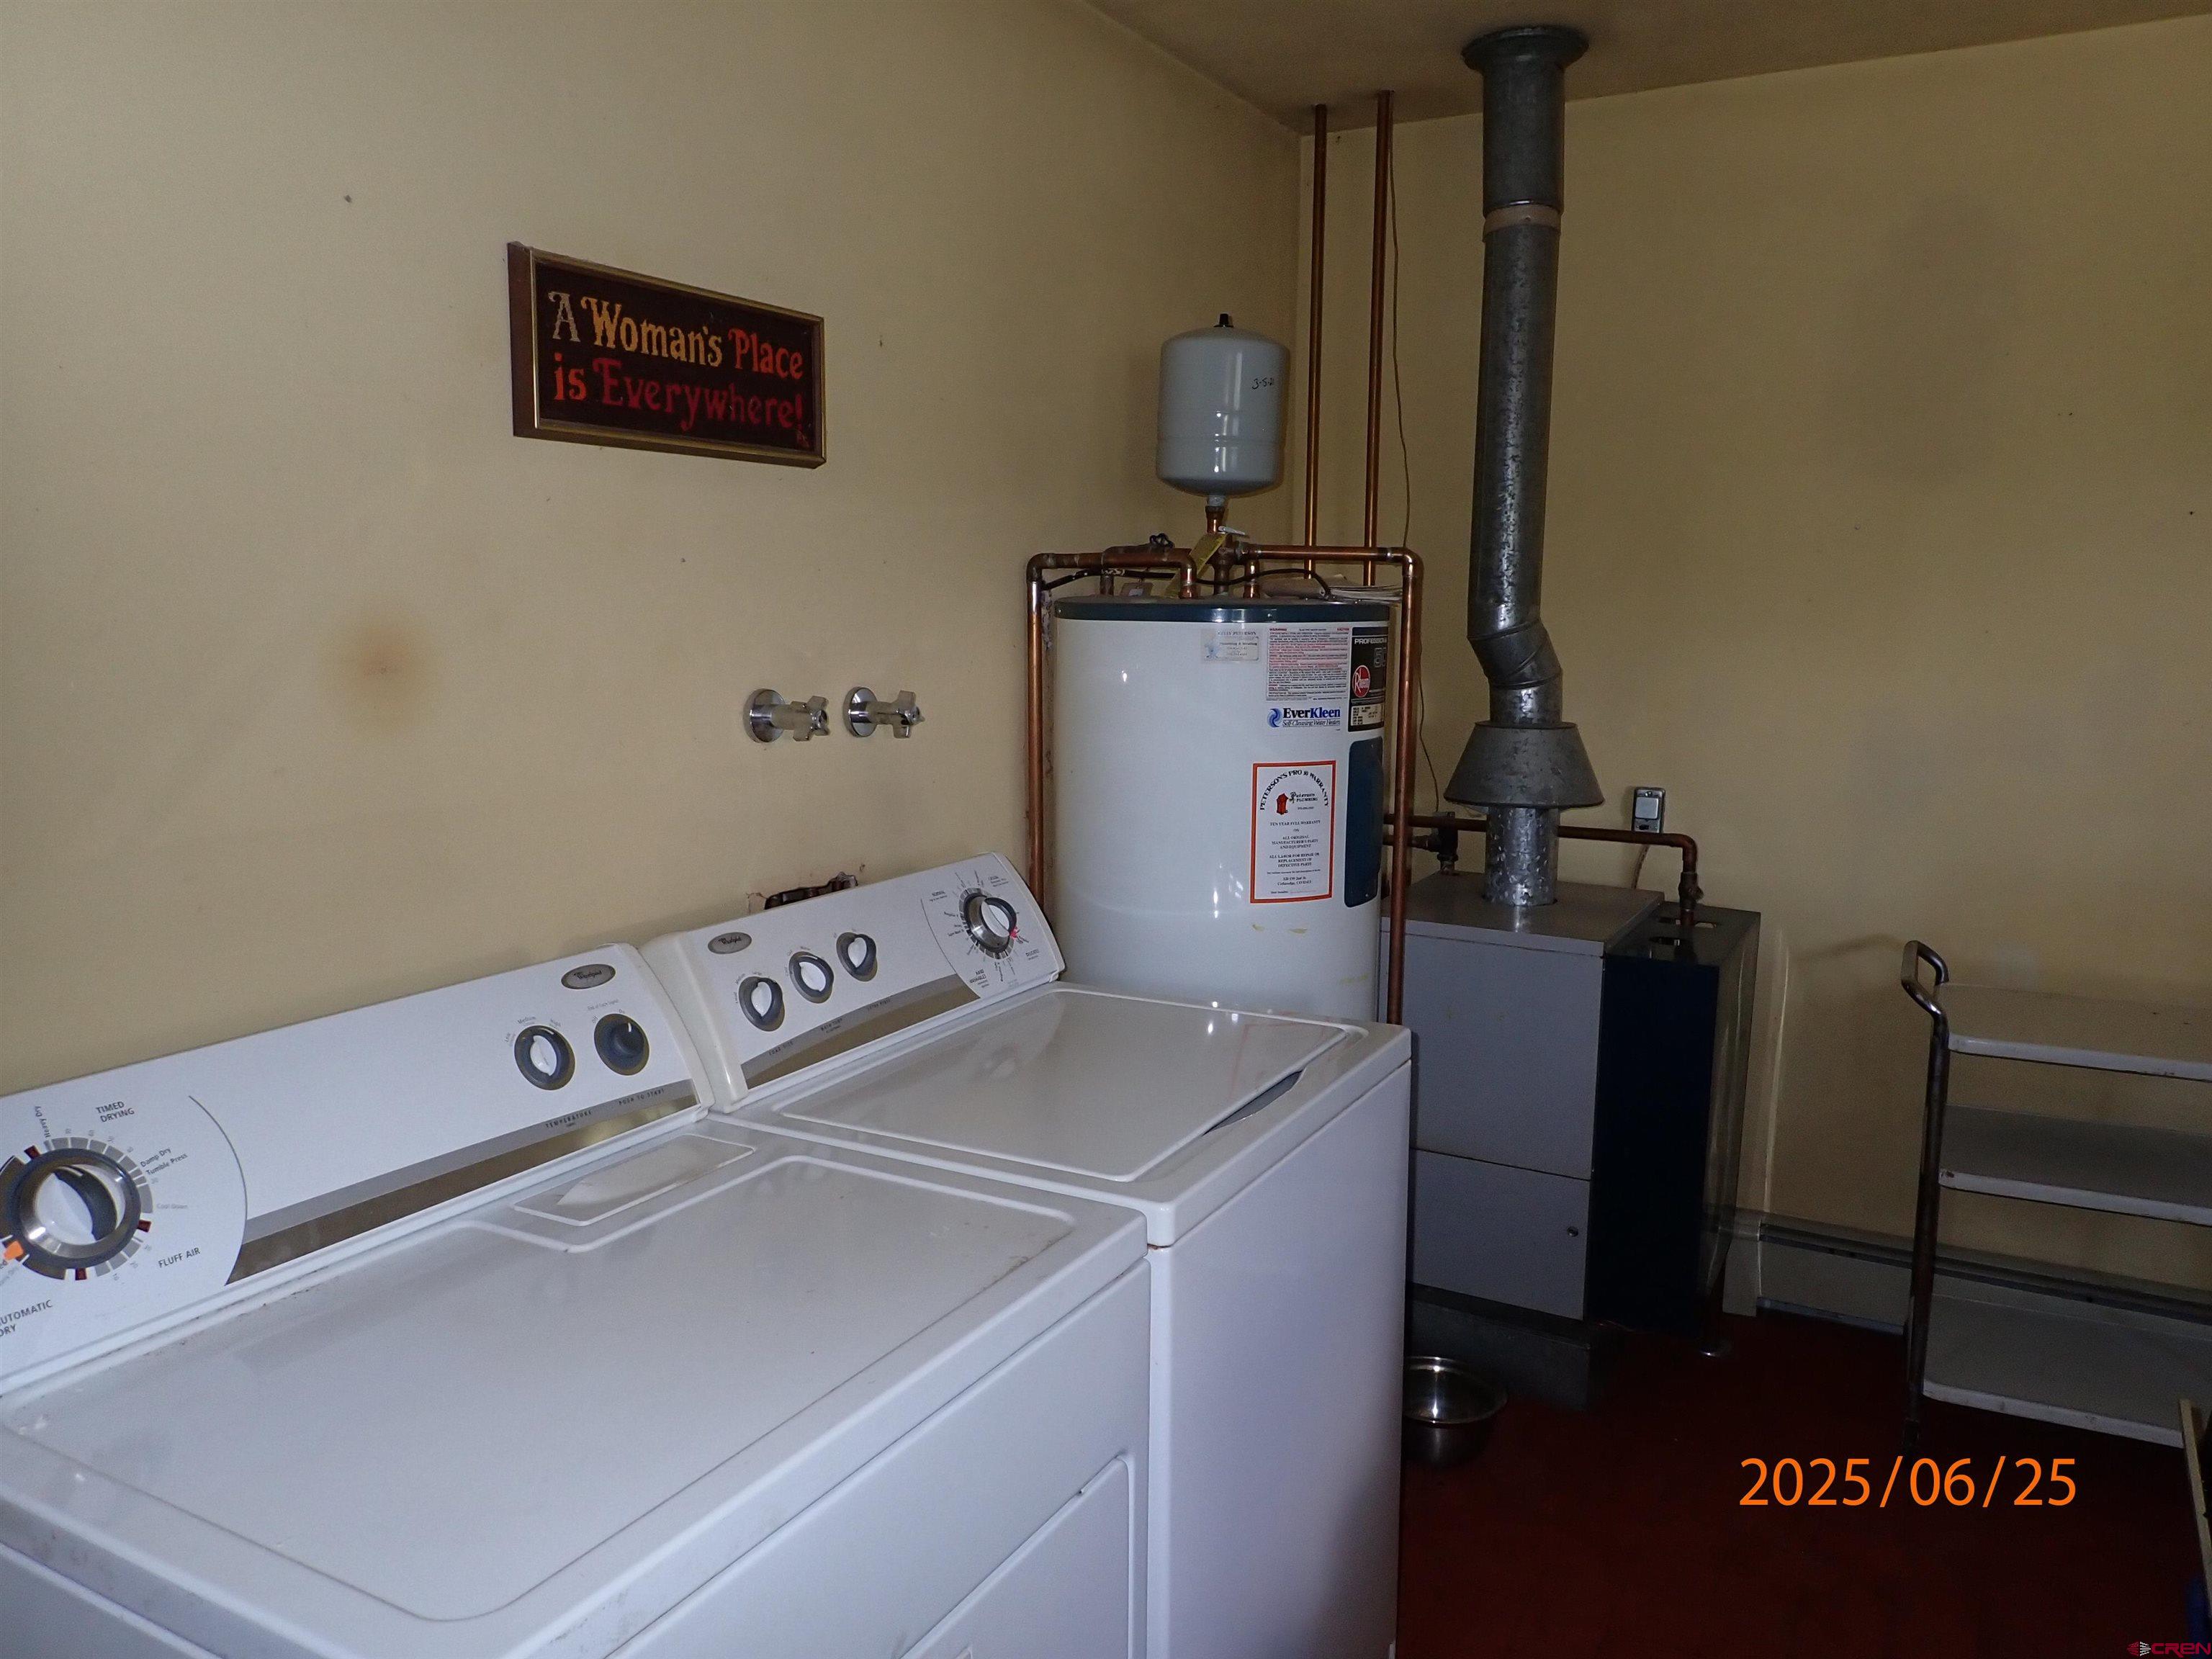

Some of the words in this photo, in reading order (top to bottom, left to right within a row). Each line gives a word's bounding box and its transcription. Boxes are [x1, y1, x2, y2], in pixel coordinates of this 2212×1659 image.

[549, 291, 580, 342] A
[581, 297, 722, 367] Woman's
[729, 328, 803, 379] Place
[554, 352, 587, 401] is
[593, 357, 803, 432] Everywhere!
[1283, 707, 1341, 719] EverKleen
[1310, 772, 1328, 806] WARRANTY
[96, 1101, 125, 1114] TIMED
[100, 1107, 135, 1123] DRYING
[545, 1110, 593, 1128] TEMPERATURE
[140, 1153, 160, 1168] Damp
[158, 1146, 172, 1159] Dry
[145, 1161, 170, 1176] Tumble
[171, 1153, 189, 1165] Press
[158, 1253, 183, 1269] FLUFF
[183, 1246, 201, 1262] AIR
[0, 1299, 53, 1326] UTOMATIC
